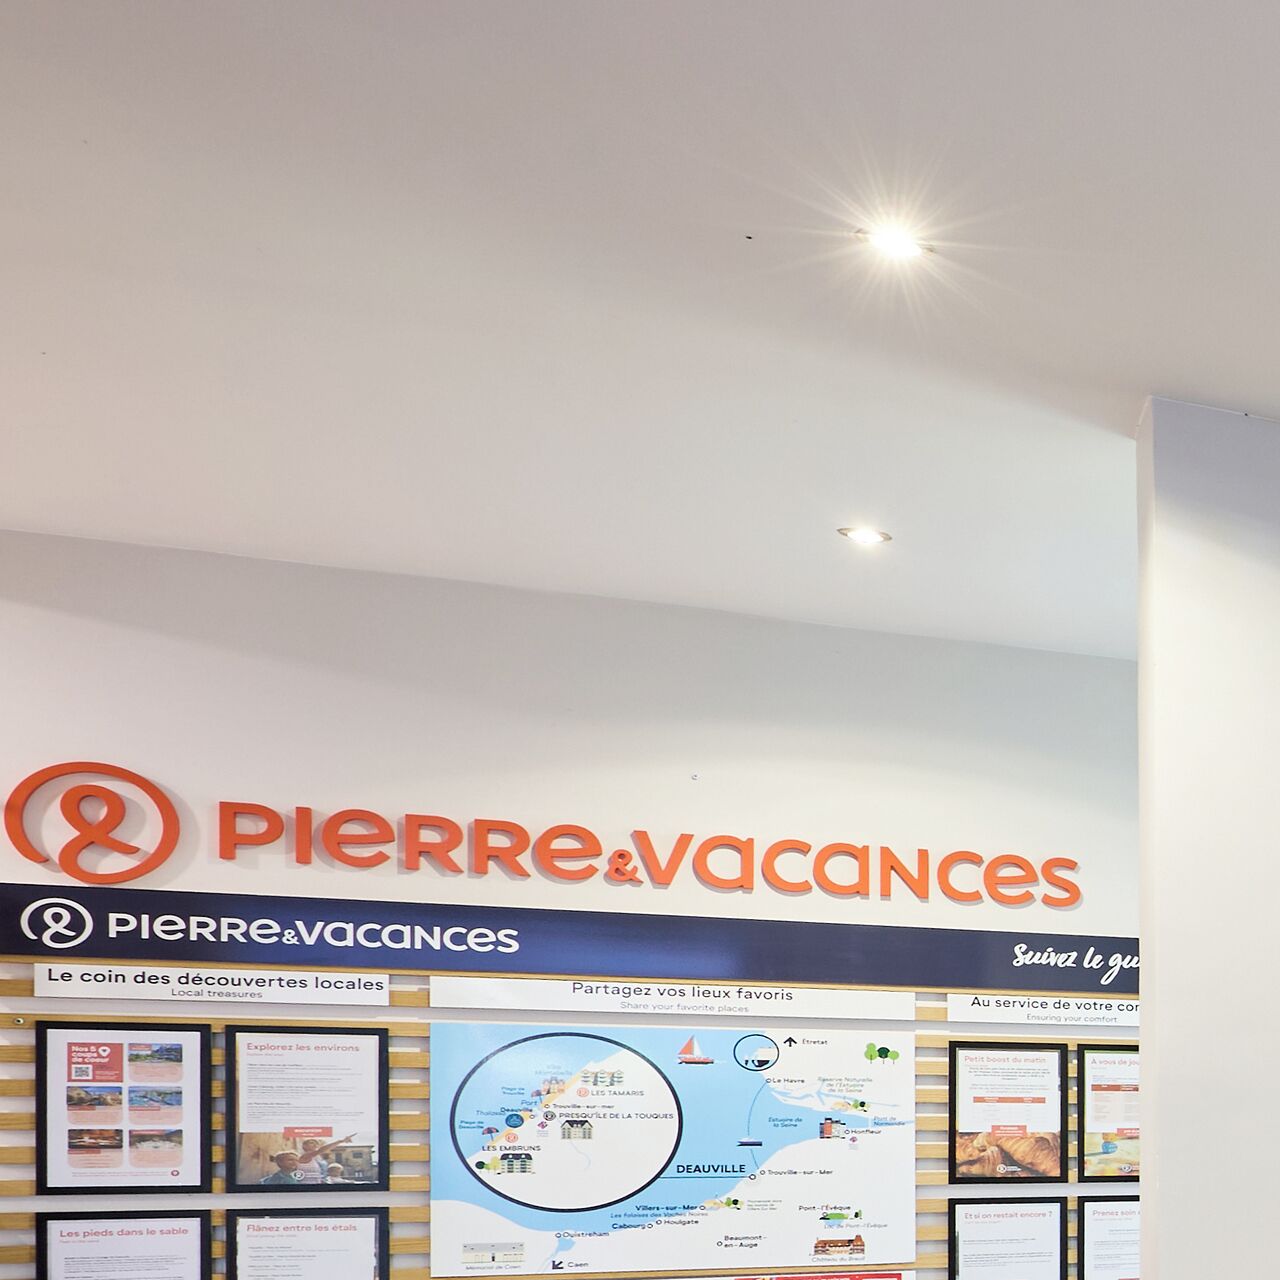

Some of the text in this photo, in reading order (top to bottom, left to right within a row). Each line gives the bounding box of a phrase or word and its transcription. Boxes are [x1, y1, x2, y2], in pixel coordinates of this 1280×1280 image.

[1012, 943, 1078, 968] Suivez
[1083, 947, 1104, 969] le
[48, 968, 384, 991] Le coin des découvertes locales
[171, 988, 263, 999] Local treasures
[572, 982, 793, 1001] Partagez vos lieux favoris
[620, 1001, 749, 1013] Share your favorite places
[971, 996, 990, 1008] Au
[995, 997, 1049, 1010] service
[1053, 1000, 1071, 1010] de
[1075, 1001, 1113, 1011] votre
[1026, 1014, 1117, 1024] Ensuring your comfort
[247, 1042, 293, 1052] Explorez
[314, 1044, 360, 1052] environs
[965, 1055, 985, 1063] Petit
[676, 1164, 746, 1174] DEAUVILLE
[964, 1212, 973, 1220] Et
[993, 1211, 1018, 1219] restait
[59, 1226, 189, 1239] Les pieds dans le sable
[247, 1224, 280, 1232] Flânez
[315, 1224, 329, 1232] les
